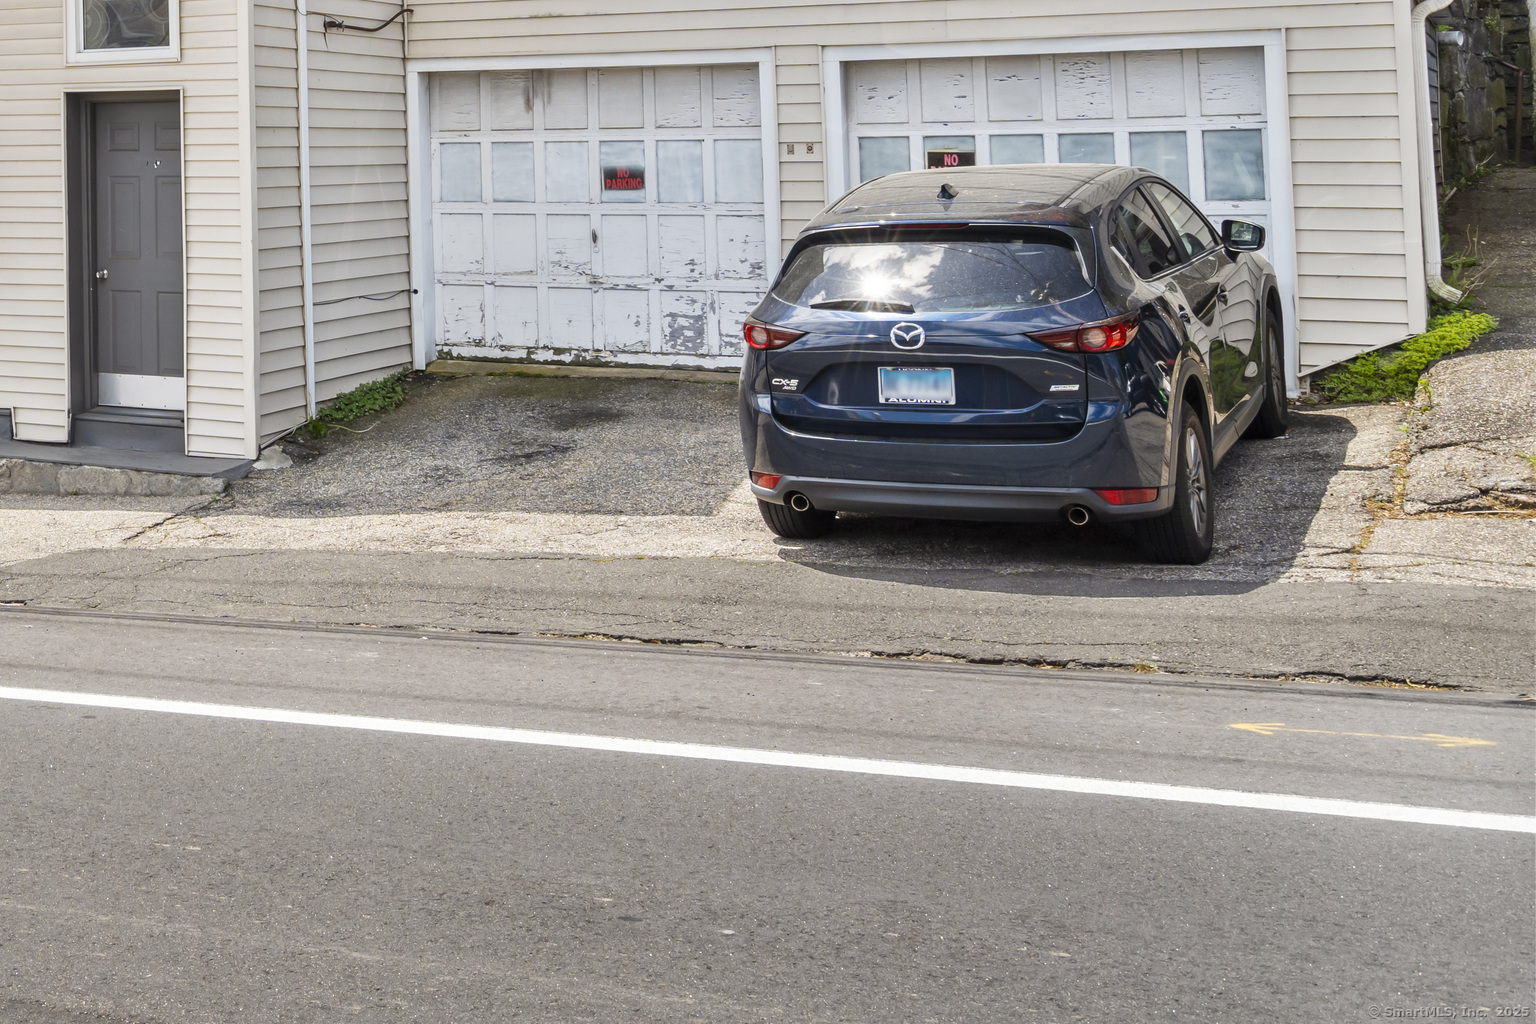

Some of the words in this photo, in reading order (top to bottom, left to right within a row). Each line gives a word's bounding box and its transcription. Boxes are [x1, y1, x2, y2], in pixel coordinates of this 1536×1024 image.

[944, 154, 958, 166] NO
[617, 168, 630, 178] NO
[606, 178, 643, 190] PARKING
[772, 378, 799, 387] CX-5
